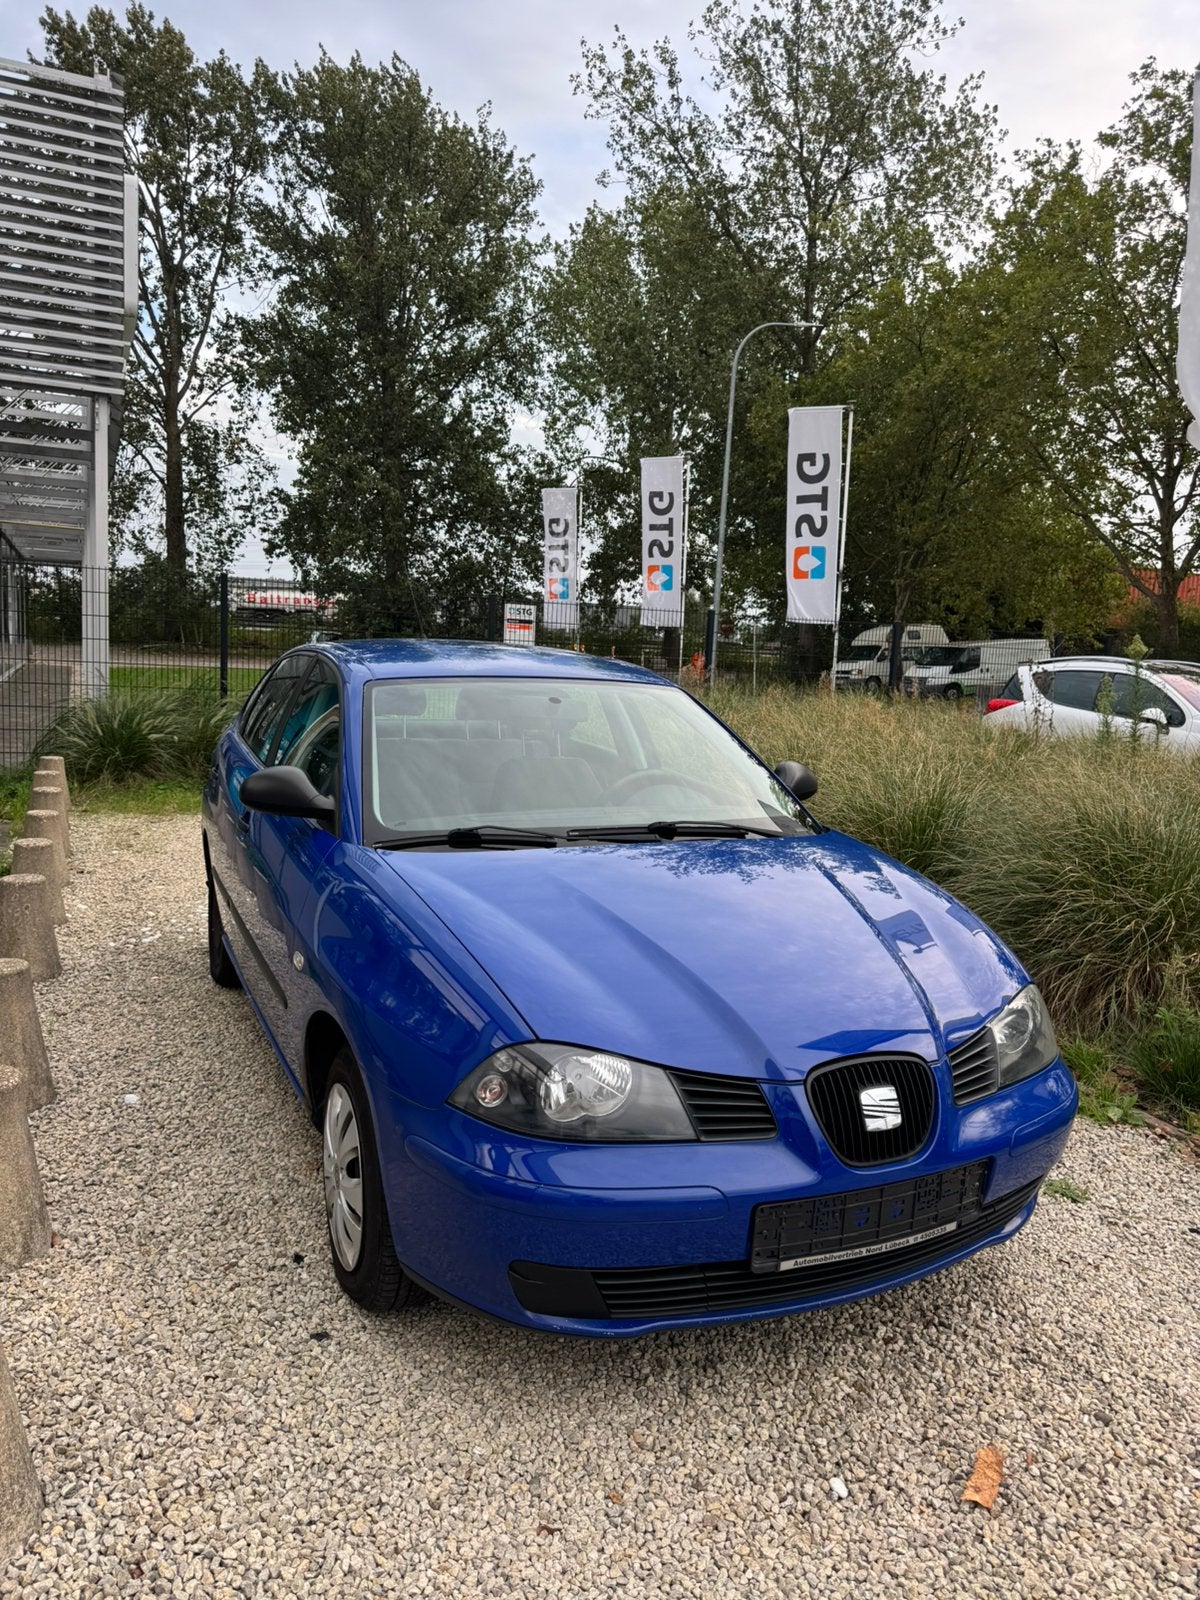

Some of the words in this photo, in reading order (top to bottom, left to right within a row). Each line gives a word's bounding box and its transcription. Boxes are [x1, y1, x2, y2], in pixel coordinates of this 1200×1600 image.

[793, 1250, 864, 1267] Automobilvertrieb
[865, 1244, 883, 1255] Nord
[884, 1238, 911, 1250] Lübeck
